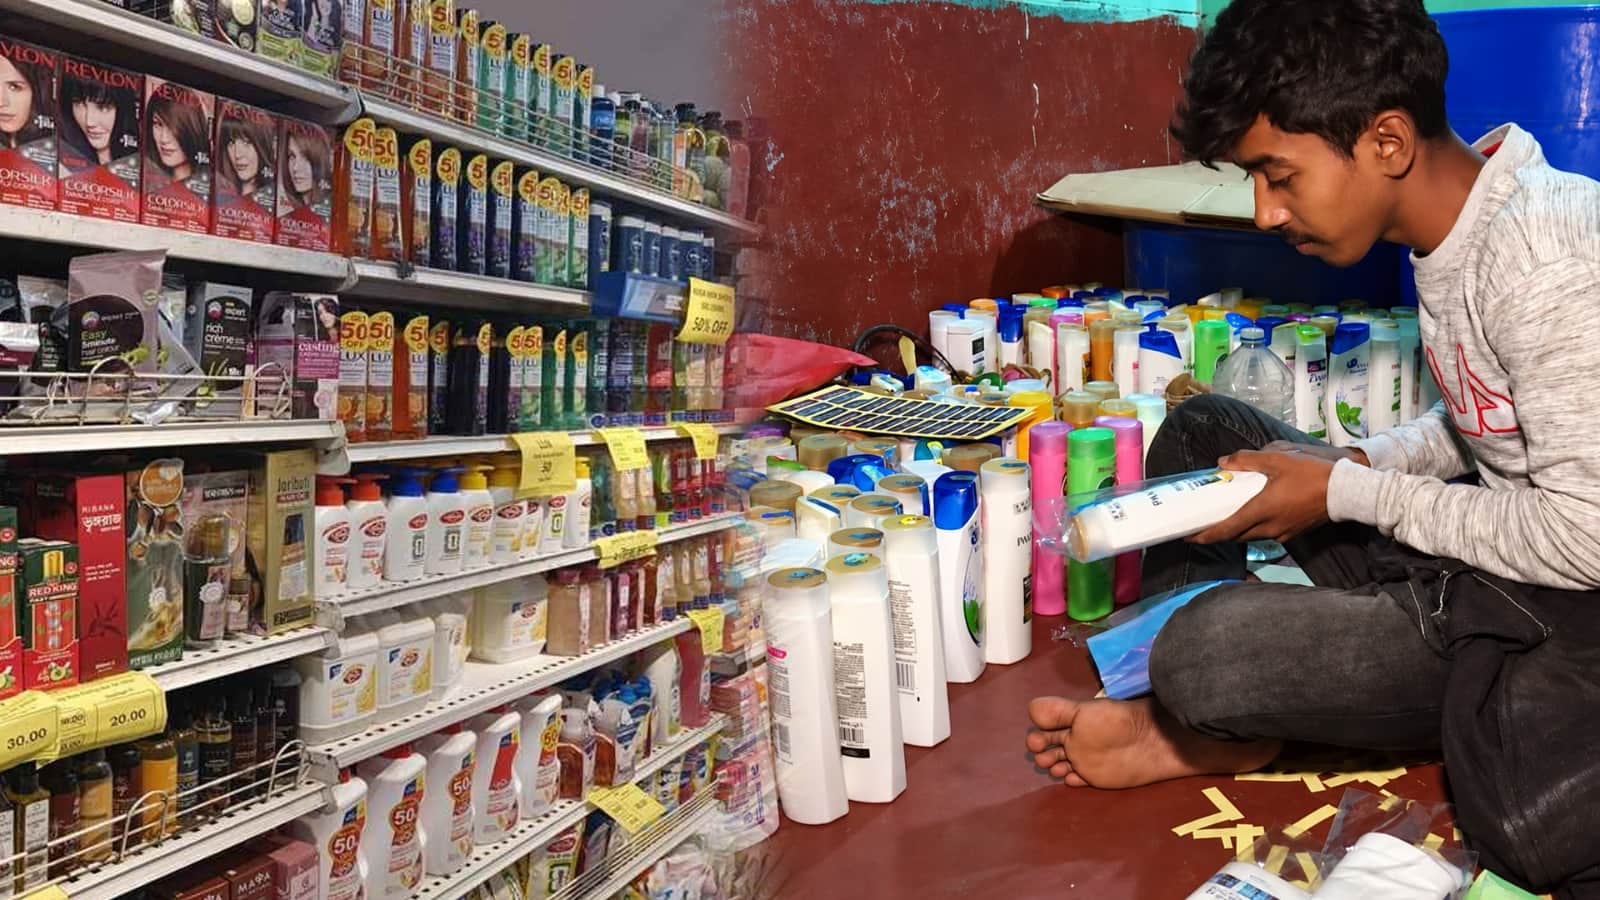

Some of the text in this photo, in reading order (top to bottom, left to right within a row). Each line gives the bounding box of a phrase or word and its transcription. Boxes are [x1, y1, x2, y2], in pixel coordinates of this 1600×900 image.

[65, 58, 139, 90] REVLON
[65, 179, 137, 200] COLORSILK
[341, 323, 368, 340] 50
[369, 323, 392, 340] 50
[29, 581, 78, 599] RED KING
[110, 708, 147, 727] 20.00
[7, 727, 48, 751] 30.00
[395, 807, 415, 825] 50
[334, 835, 356, 855] 50
